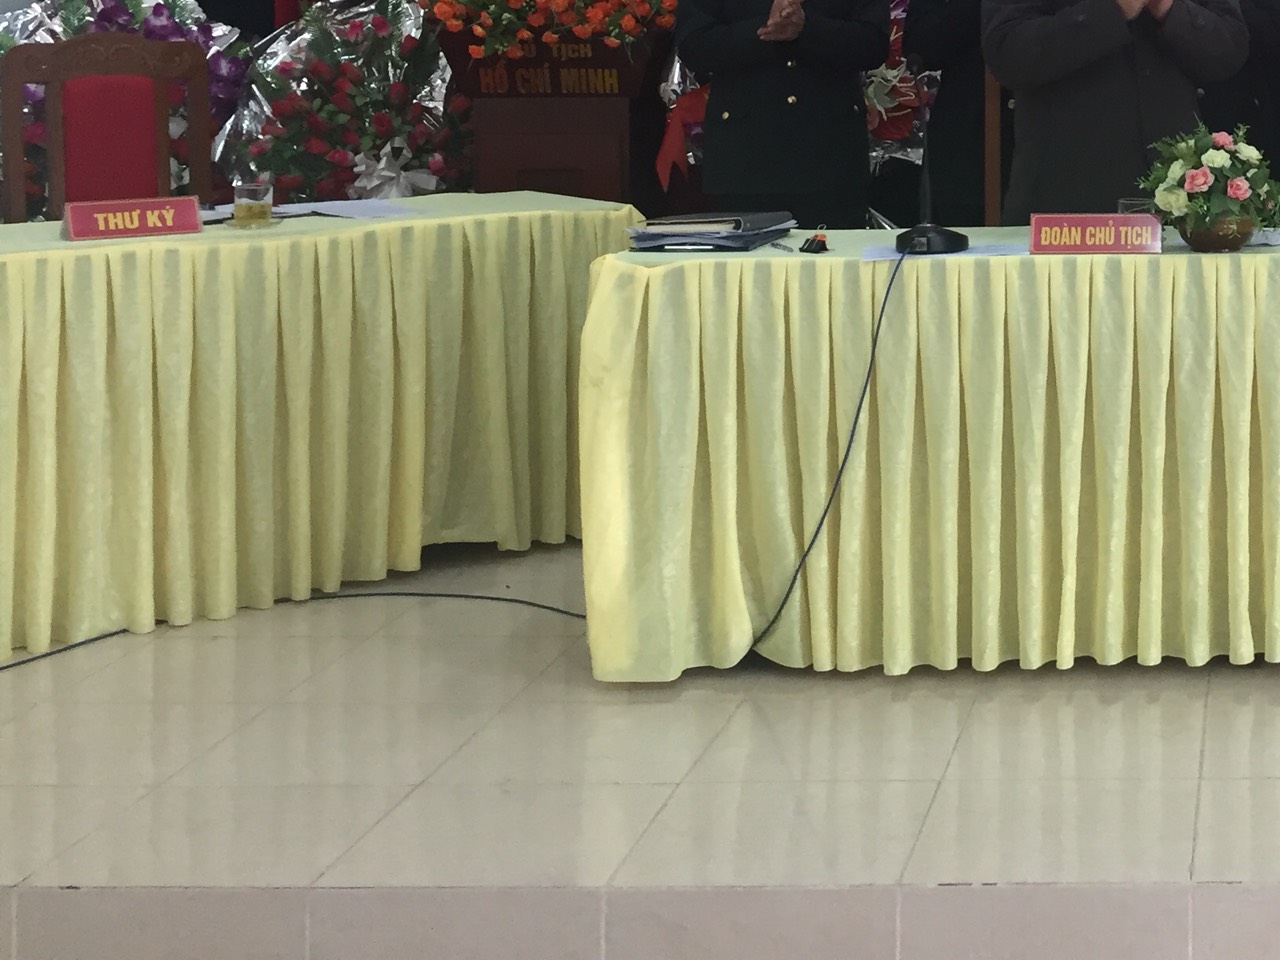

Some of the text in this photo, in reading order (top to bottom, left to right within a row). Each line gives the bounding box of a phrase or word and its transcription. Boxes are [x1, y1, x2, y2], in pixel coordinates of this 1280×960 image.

[560, 68, 620, 94] MINH
[94, 209, 140, 231] THƯ
[1040, 220, 1152, 250] ĐOÀN CHỦ TỊCH
